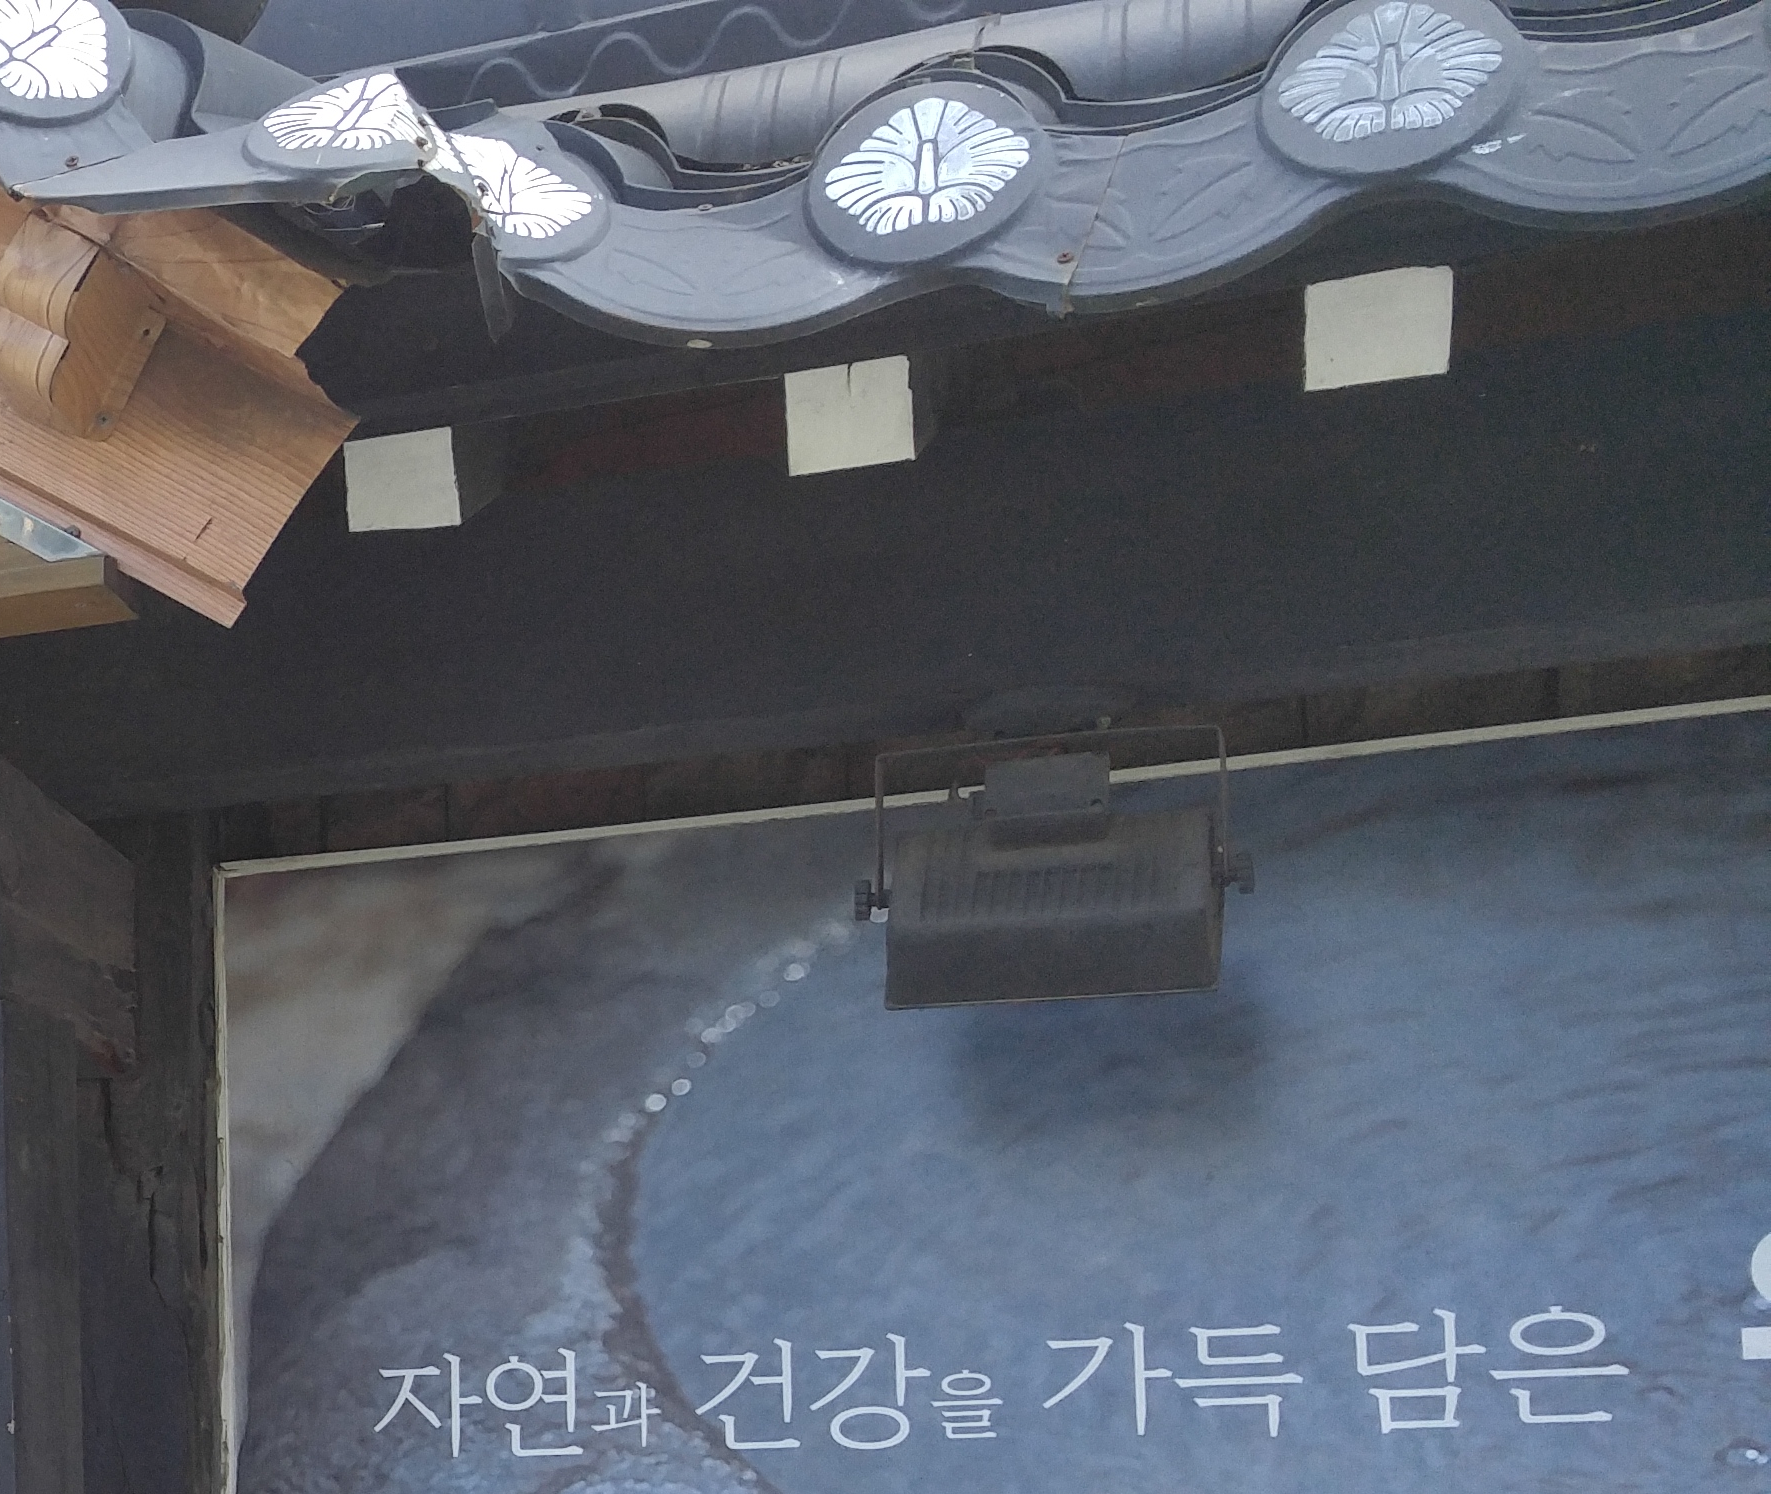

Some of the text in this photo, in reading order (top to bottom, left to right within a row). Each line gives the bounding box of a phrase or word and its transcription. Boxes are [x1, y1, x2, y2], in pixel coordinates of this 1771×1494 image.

[373, 1305, 1631, 1458] 자연과 건강을 가득 담은
